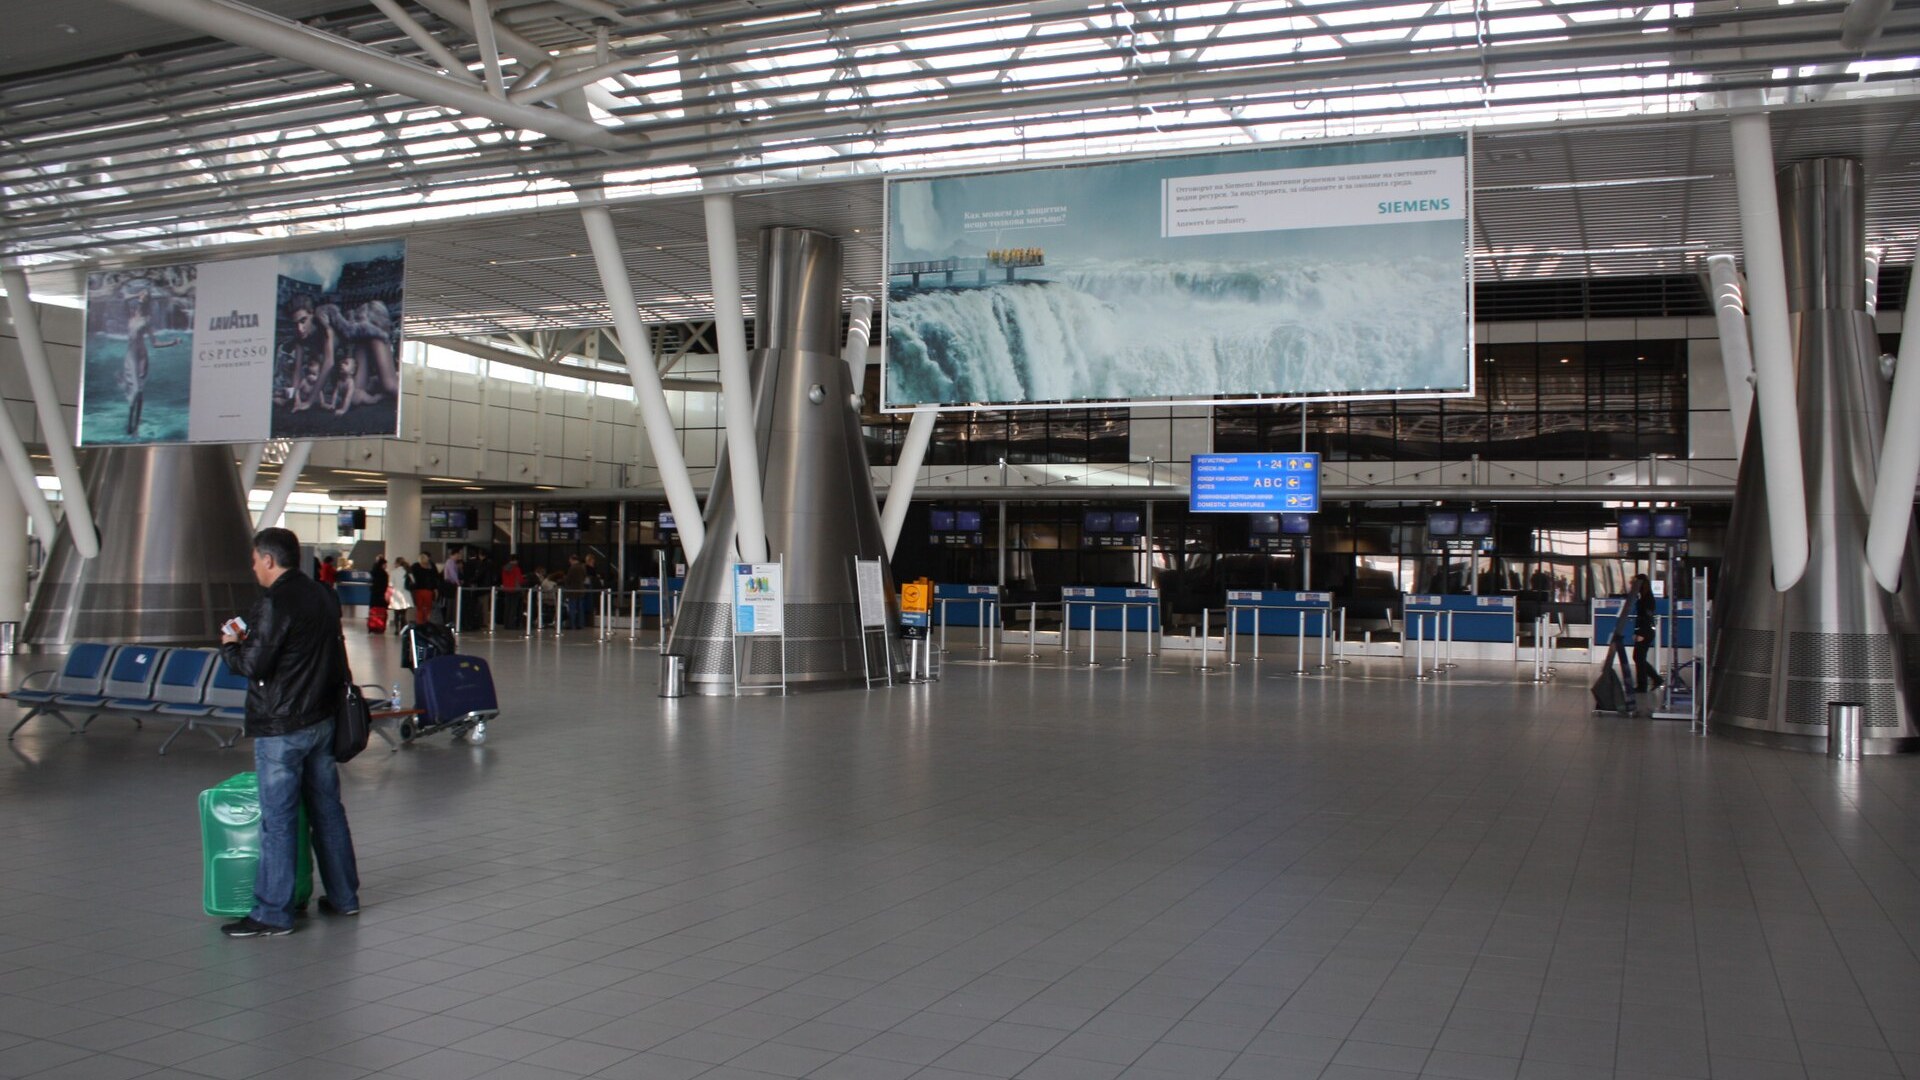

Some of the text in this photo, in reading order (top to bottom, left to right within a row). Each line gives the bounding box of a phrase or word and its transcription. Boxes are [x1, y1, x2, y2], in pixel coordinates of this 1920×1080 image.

[1378, 198, 1450, 214] SIEMENS
[964, 211, 980, 220] Как
[981, 210, 1012, 219] можем
[1013, 209, 1024, 217] да
[1176, 219, 1204, 228] Answers
[209, 310, 259, 331] LAVAZZA
[1270, 459, 1282, 469] 24
